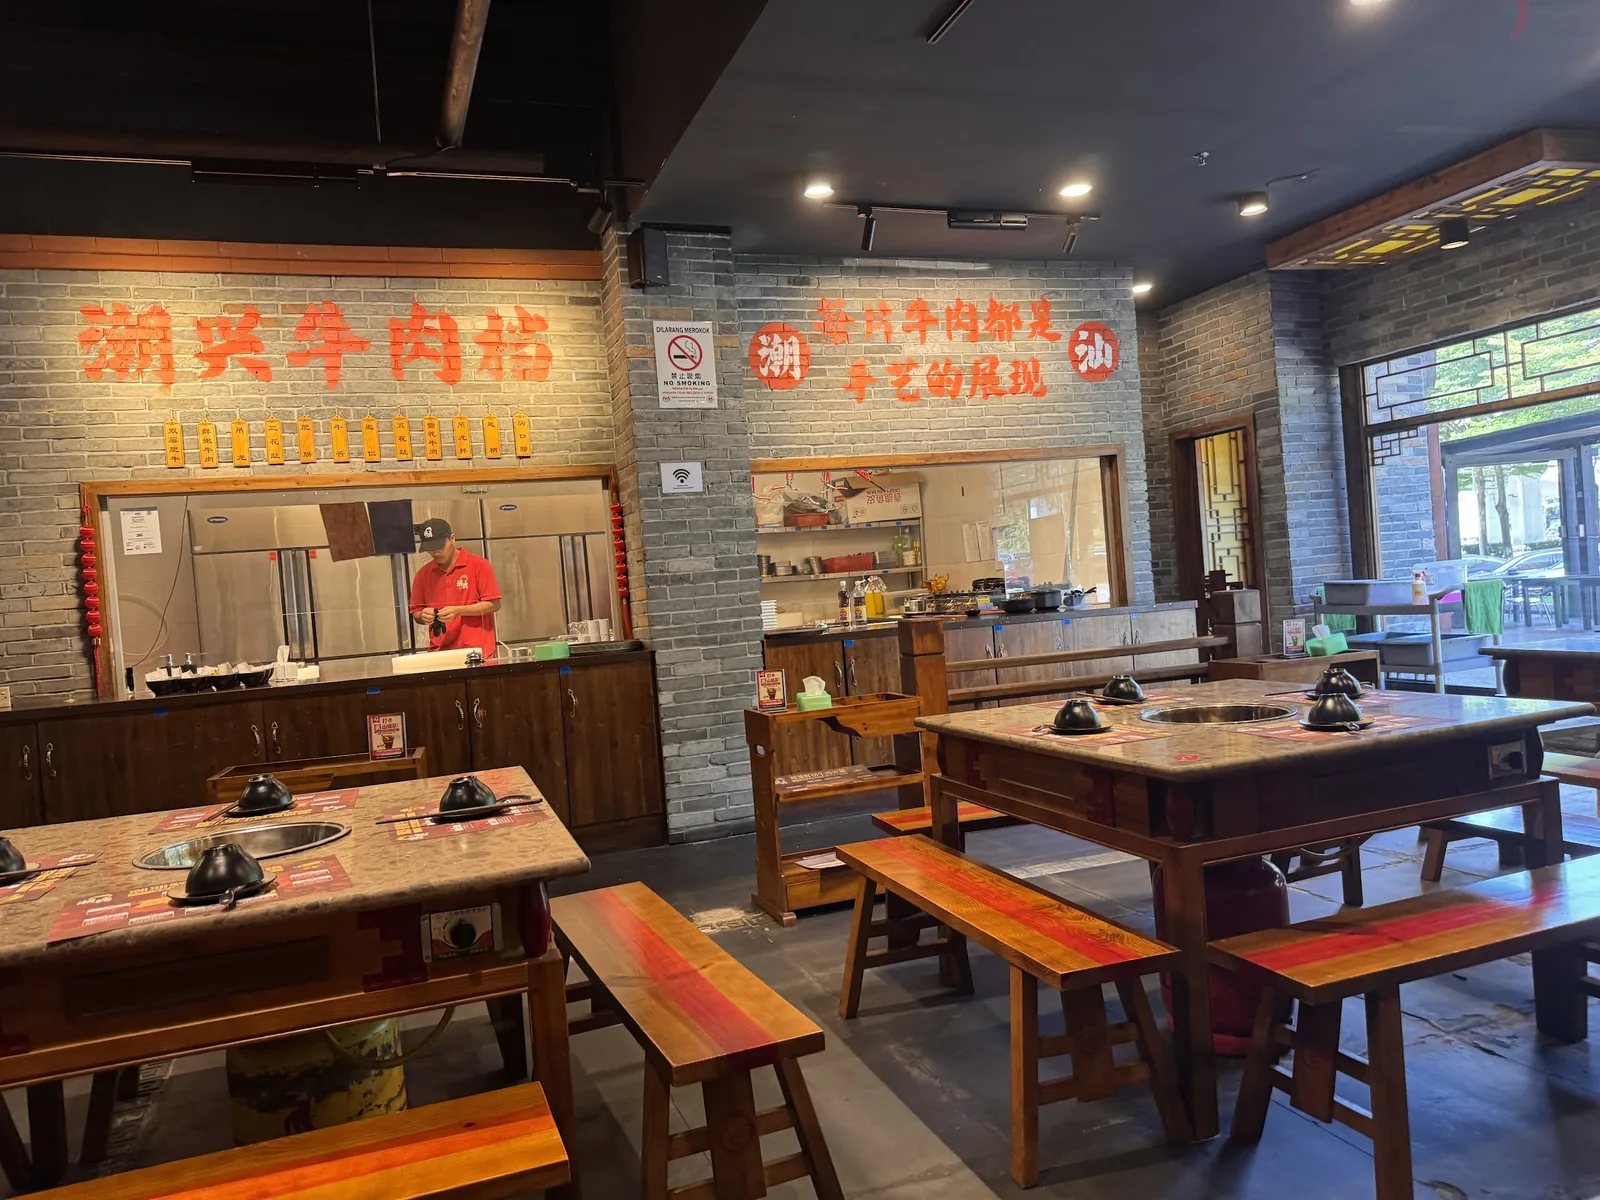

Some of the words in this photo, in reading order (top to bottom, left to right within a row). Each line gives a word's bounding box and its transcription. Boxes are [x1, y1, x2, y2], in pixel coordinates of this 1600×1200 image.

[78, 300, 553, 389] 潮兴牛肉档
[813, 296, 1062, 345] 每片牛肉都是
[757, 333, 803, 381] 潮
[1074, 330, 1113, 373] 汕
[843, 355, 1047, 404] 手艺的展现
[168, 428, 180, 462] 双层肥牛
[235, 427, 247, 461] 吊龙
